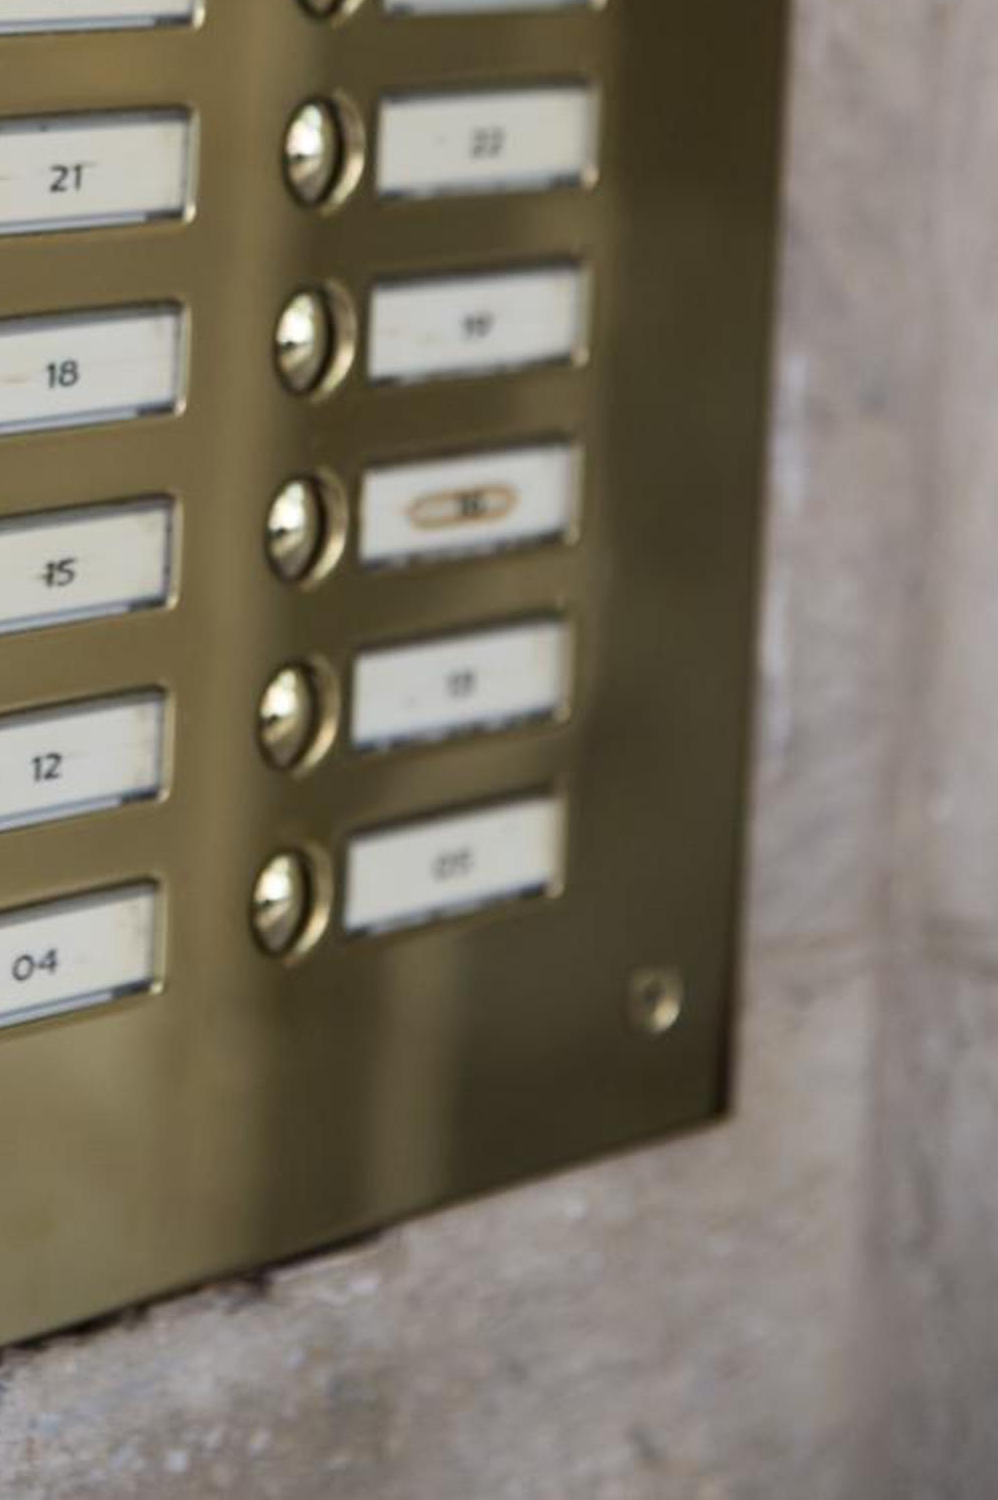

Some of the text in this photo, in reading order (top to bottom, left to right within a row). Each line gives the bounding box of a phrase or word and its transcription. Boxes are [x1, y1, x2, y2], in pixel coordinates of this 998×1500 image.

[49, 163, 84, 193] 21
[45, 359, 80, 389] 18
[40, 557, 77, 587] 15
[31, 751, 64, 783] 12
[10, 947, 59, 983] 04
